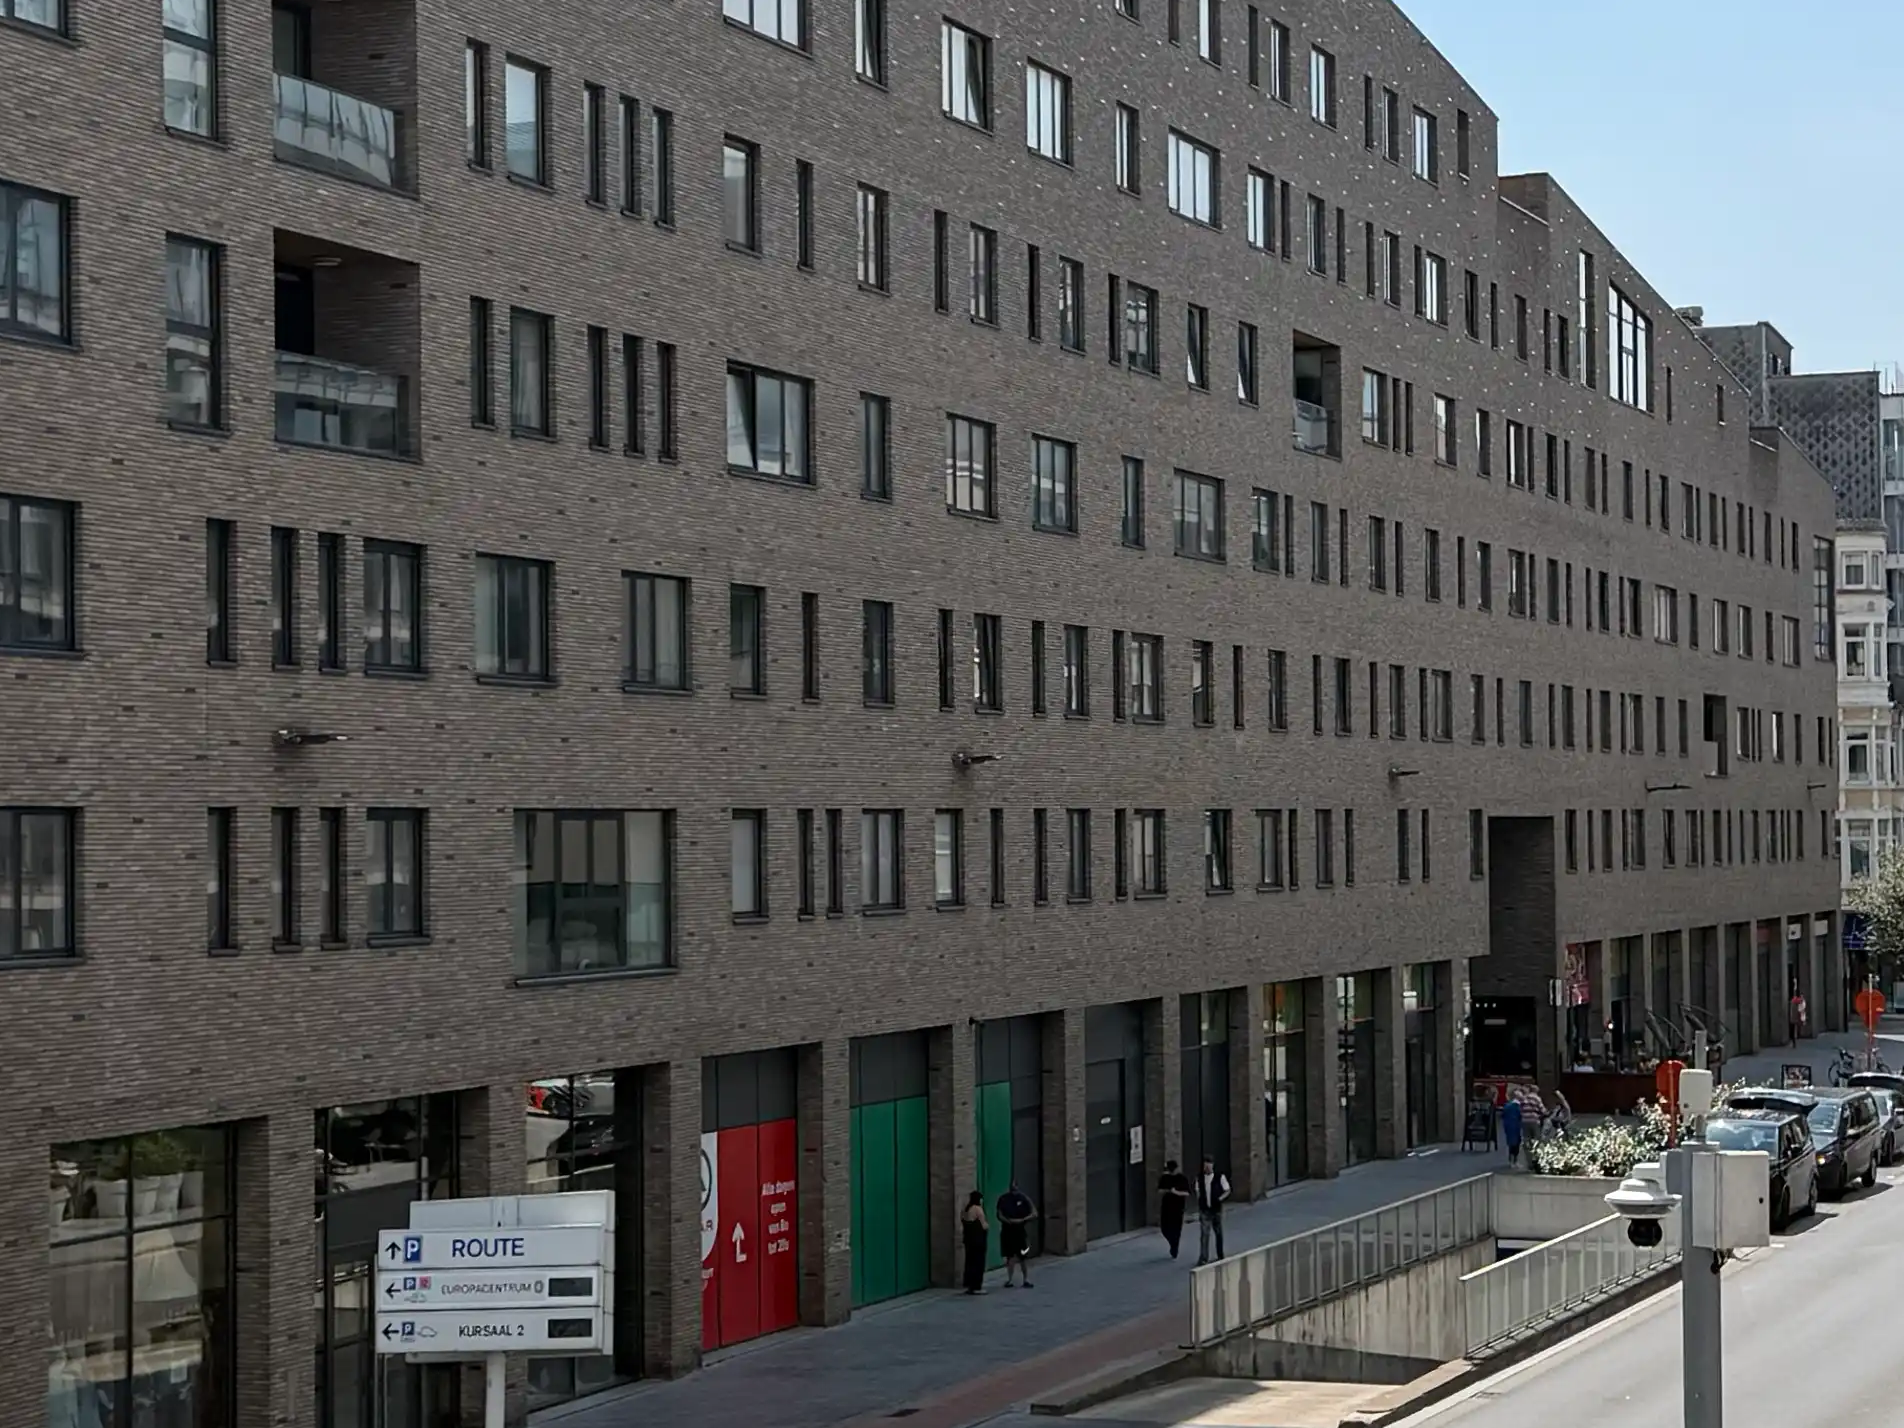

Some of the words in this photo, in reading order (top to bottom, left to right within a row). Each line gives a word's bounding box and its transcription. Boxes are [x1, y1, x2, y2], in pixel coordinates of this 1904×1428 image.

[407, 1239, 419, 1259] P
[452, 1238, 525, 1257] ROUTE
[459, 1324, 512, 1337] KURSAAL
[517, 1324, 525, 1337] 2
